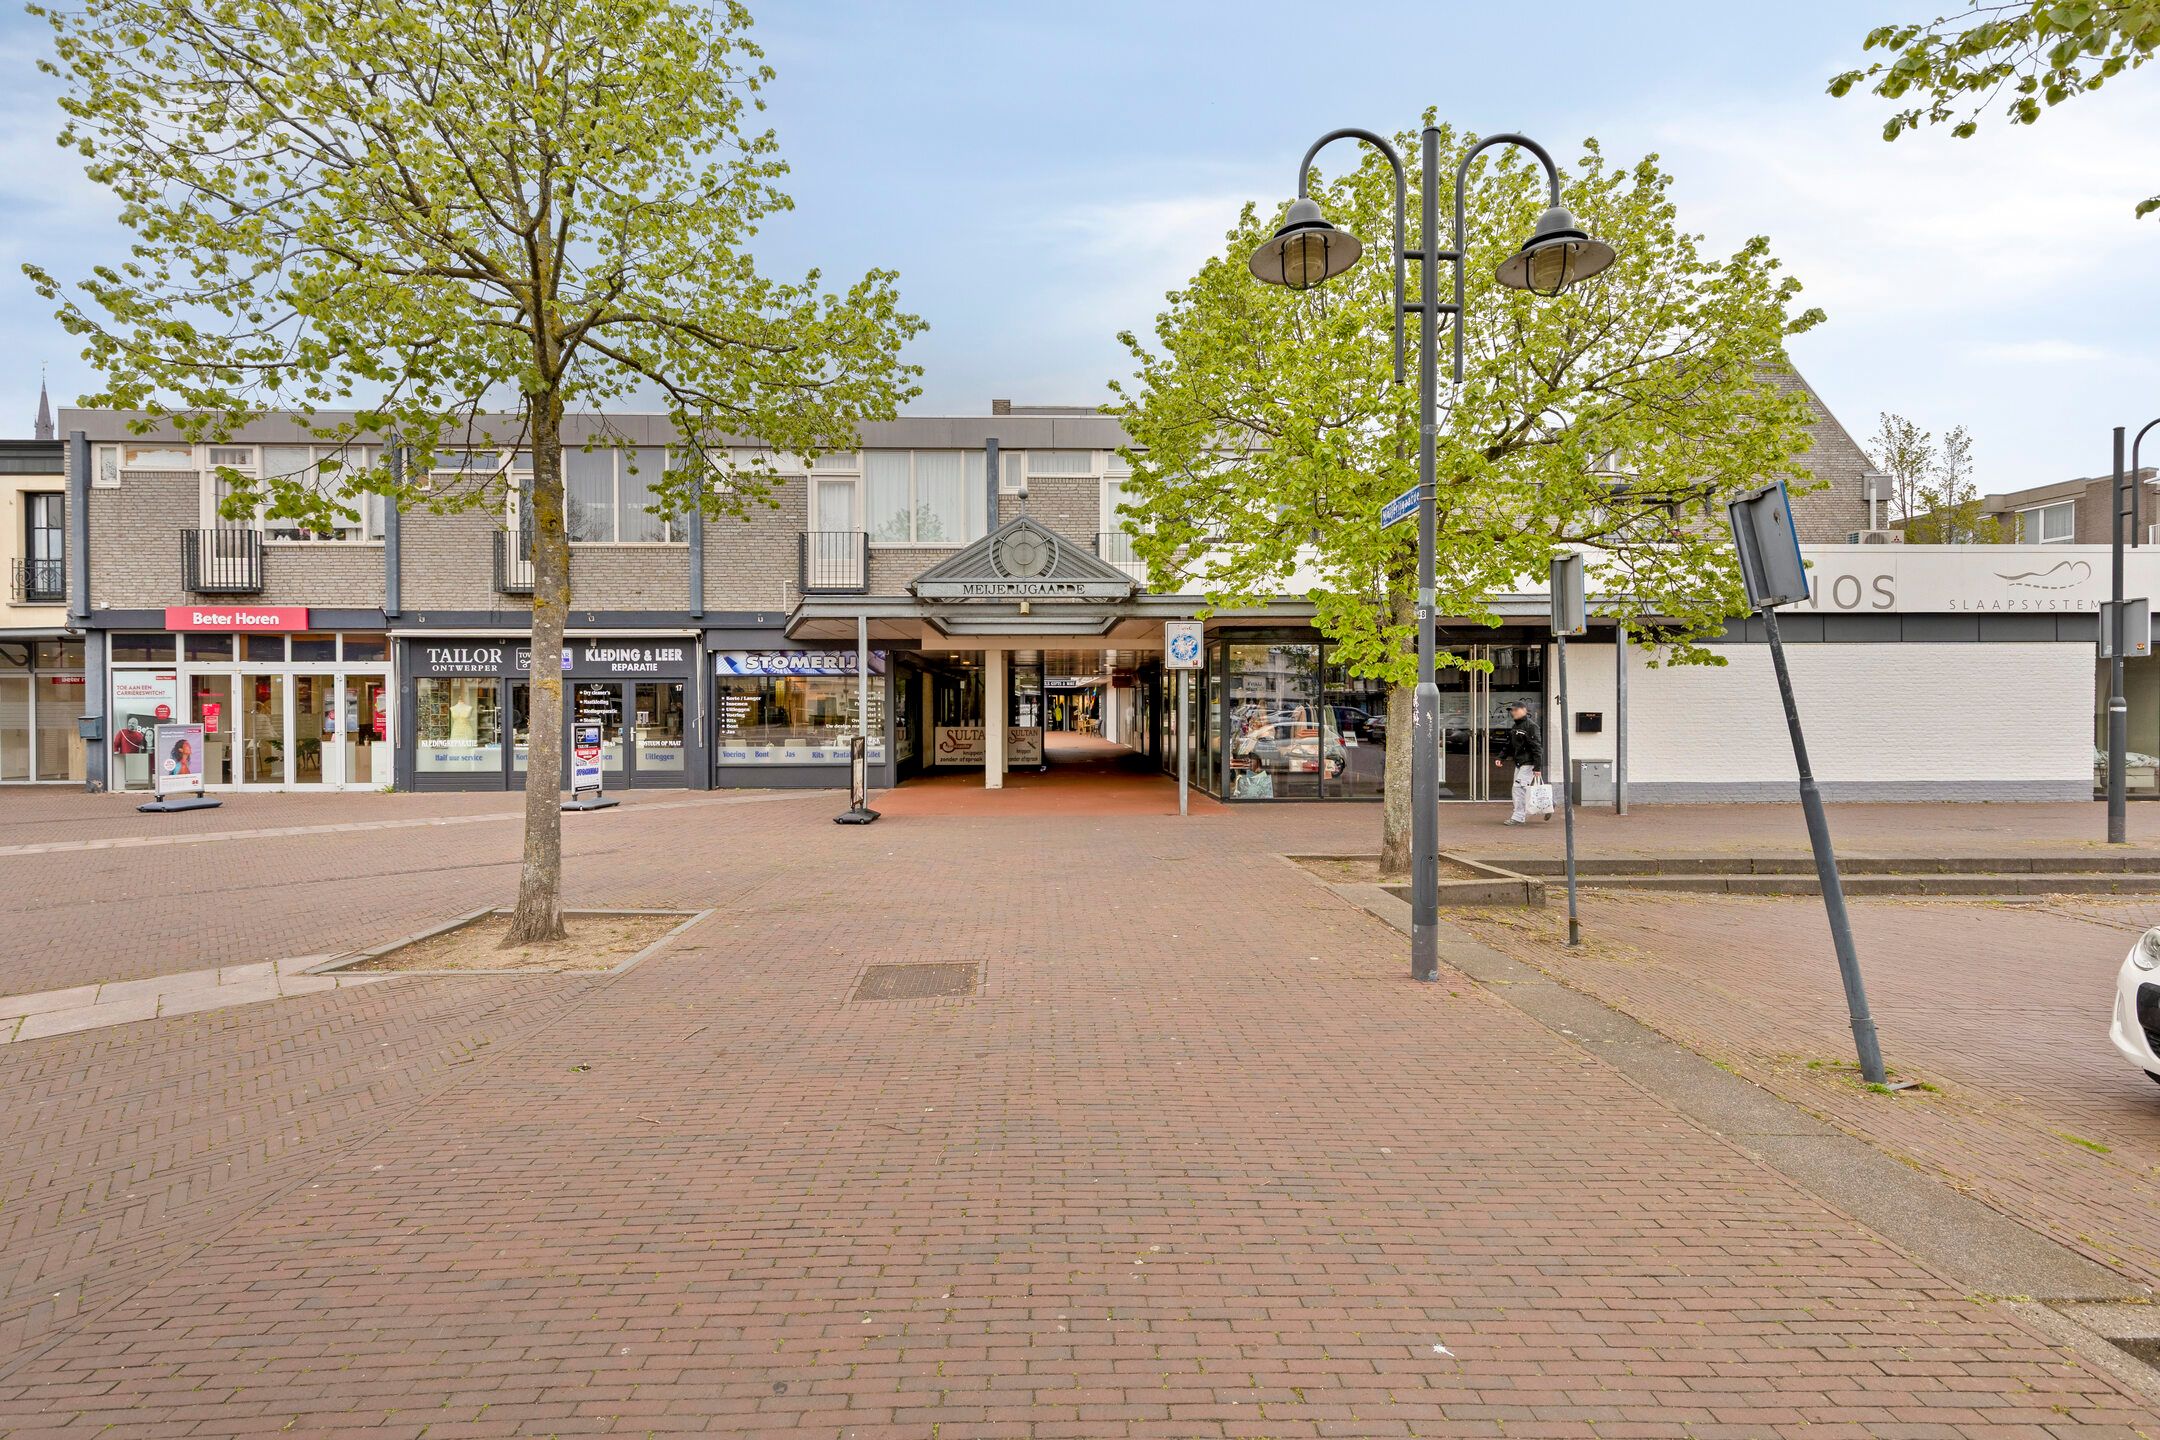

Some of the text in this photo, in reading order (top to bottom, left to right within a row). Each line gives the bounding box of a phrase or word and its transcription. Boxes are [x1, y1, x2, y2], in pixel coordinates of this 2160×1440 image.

[963, 584, 1086, 595] MEIJERIJGAARDE
[1949, 599, 2100, 610] SLAAPSYSTEM
[192, 612, 280, 625] Beter Horen
[426, 648, 503, 664] TAILOR
[585, 648, 683, 662] KLEDING & LEER
[431, 664, 498, 672] ONTWERPER
[611, 663, 658, 672] REPARATIE
[745, 655, 858, 670] STOMERIJ
[941, 729, 986, 753] SULTA
[645, 753, 675, 761] Uitleggen
[723, 751, 746, 759] Voering
